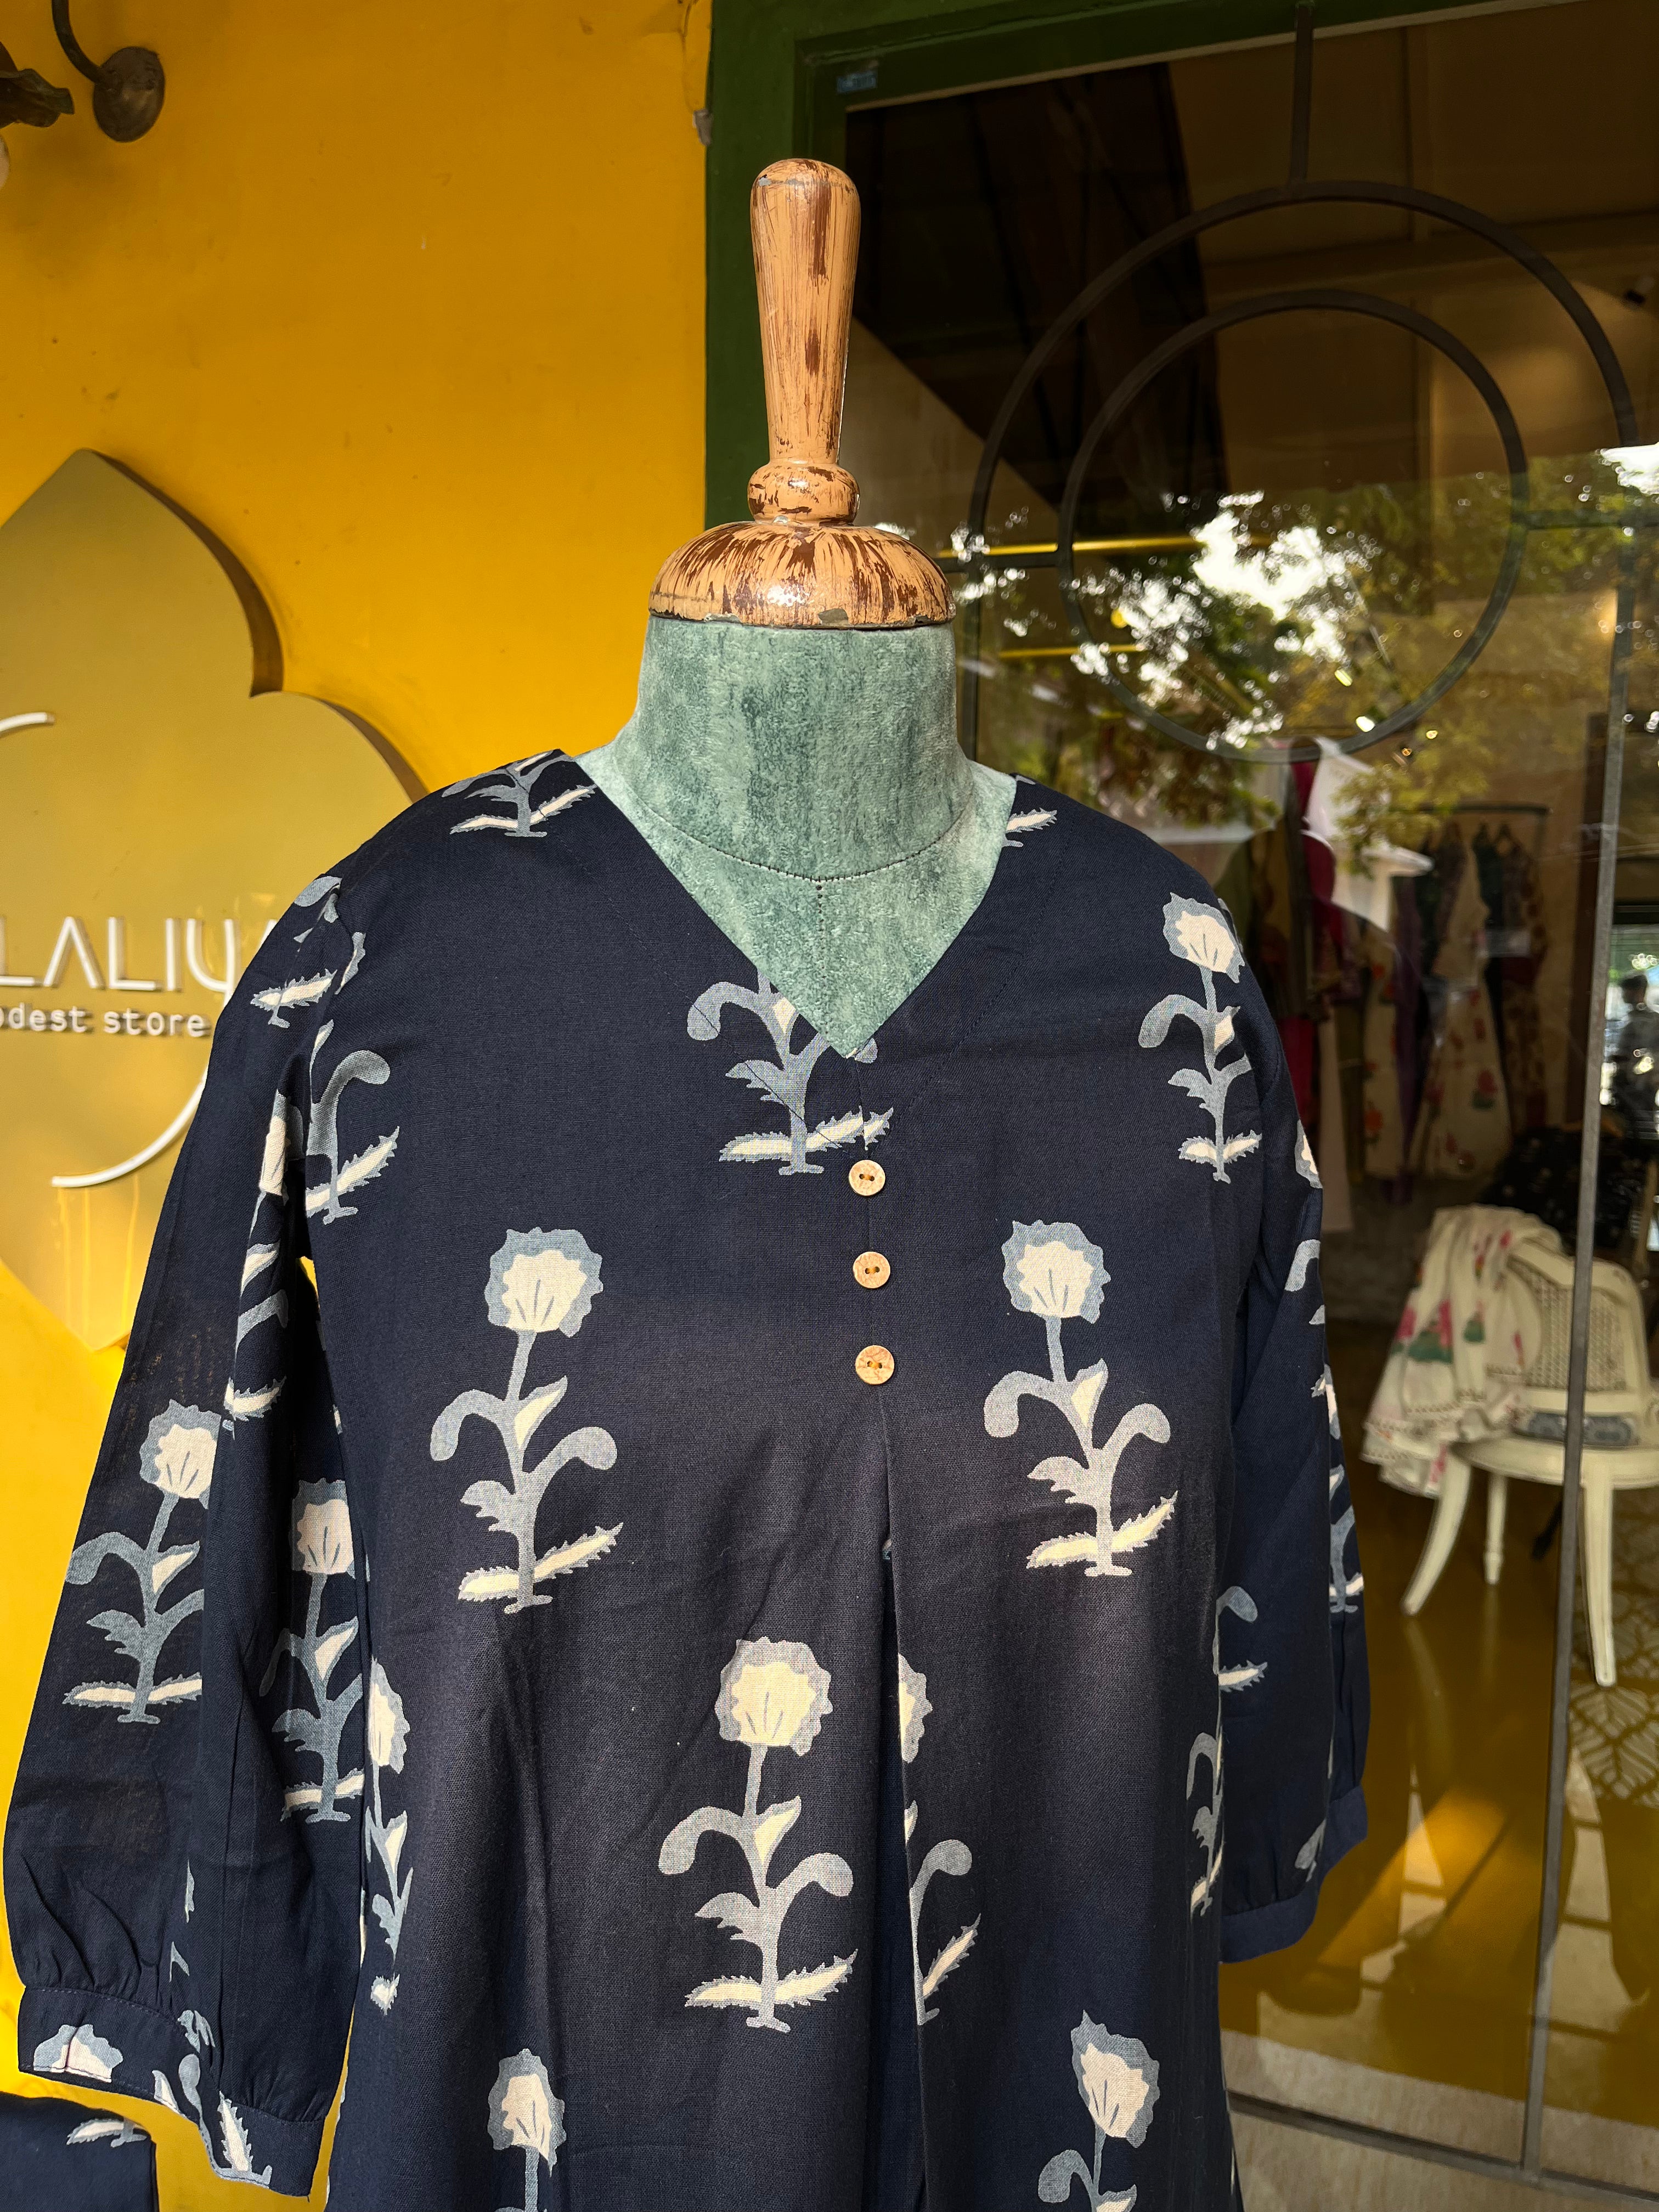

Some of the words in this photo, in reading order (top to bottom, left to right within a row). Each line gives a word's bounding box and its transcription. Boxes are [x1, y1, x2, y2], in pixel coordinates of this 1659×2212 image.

[0, 916, 278, 1008] LALIY
[0, 1002, 87, 1034] dest
[104, 1007, 205, 1037] store
